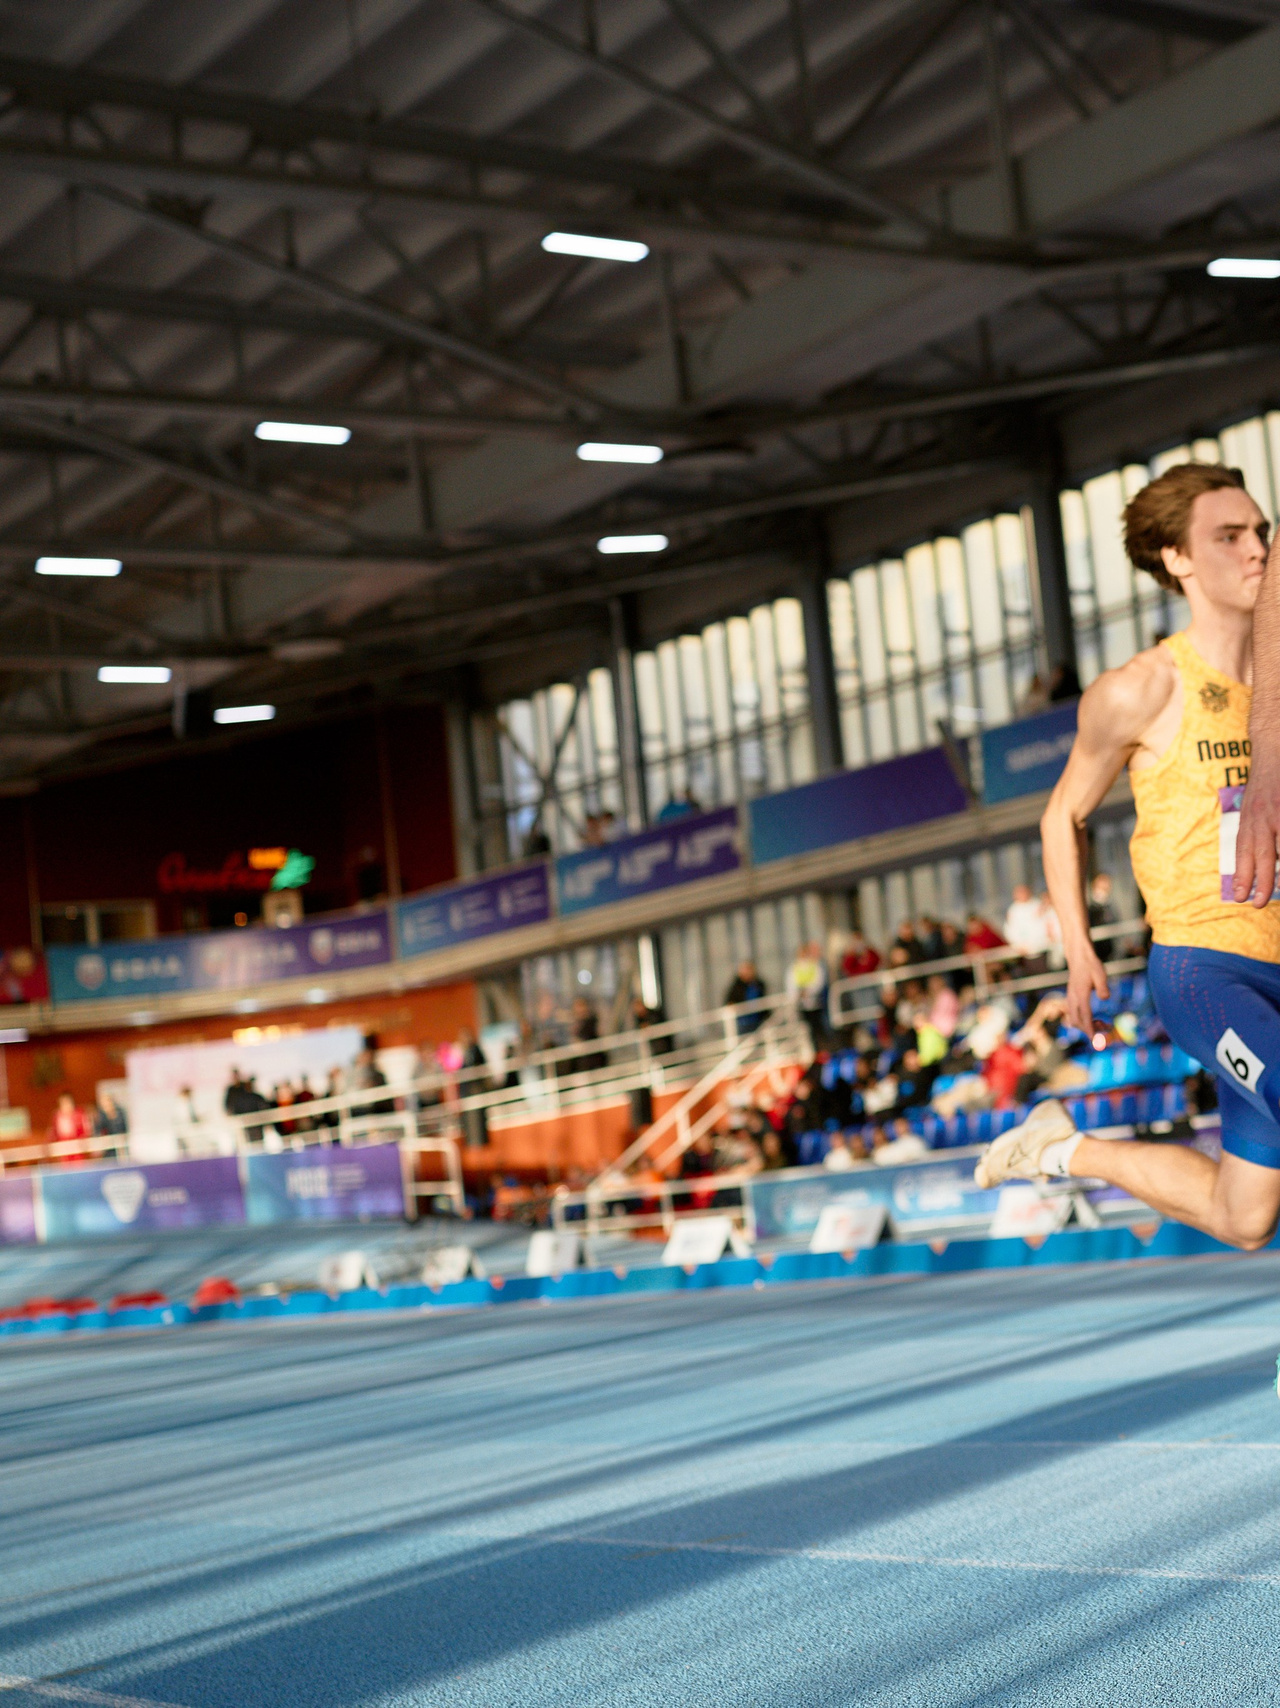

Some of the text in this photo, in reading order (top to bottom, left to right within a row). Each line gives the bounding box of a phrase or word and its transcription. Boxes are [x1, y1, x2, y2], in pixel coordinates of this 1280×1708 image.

[1197, 739, 1252, 762] Пово
[1225, 766, 1249, 787] ГУ
[1225, 1048, 1249, 1081] 6
